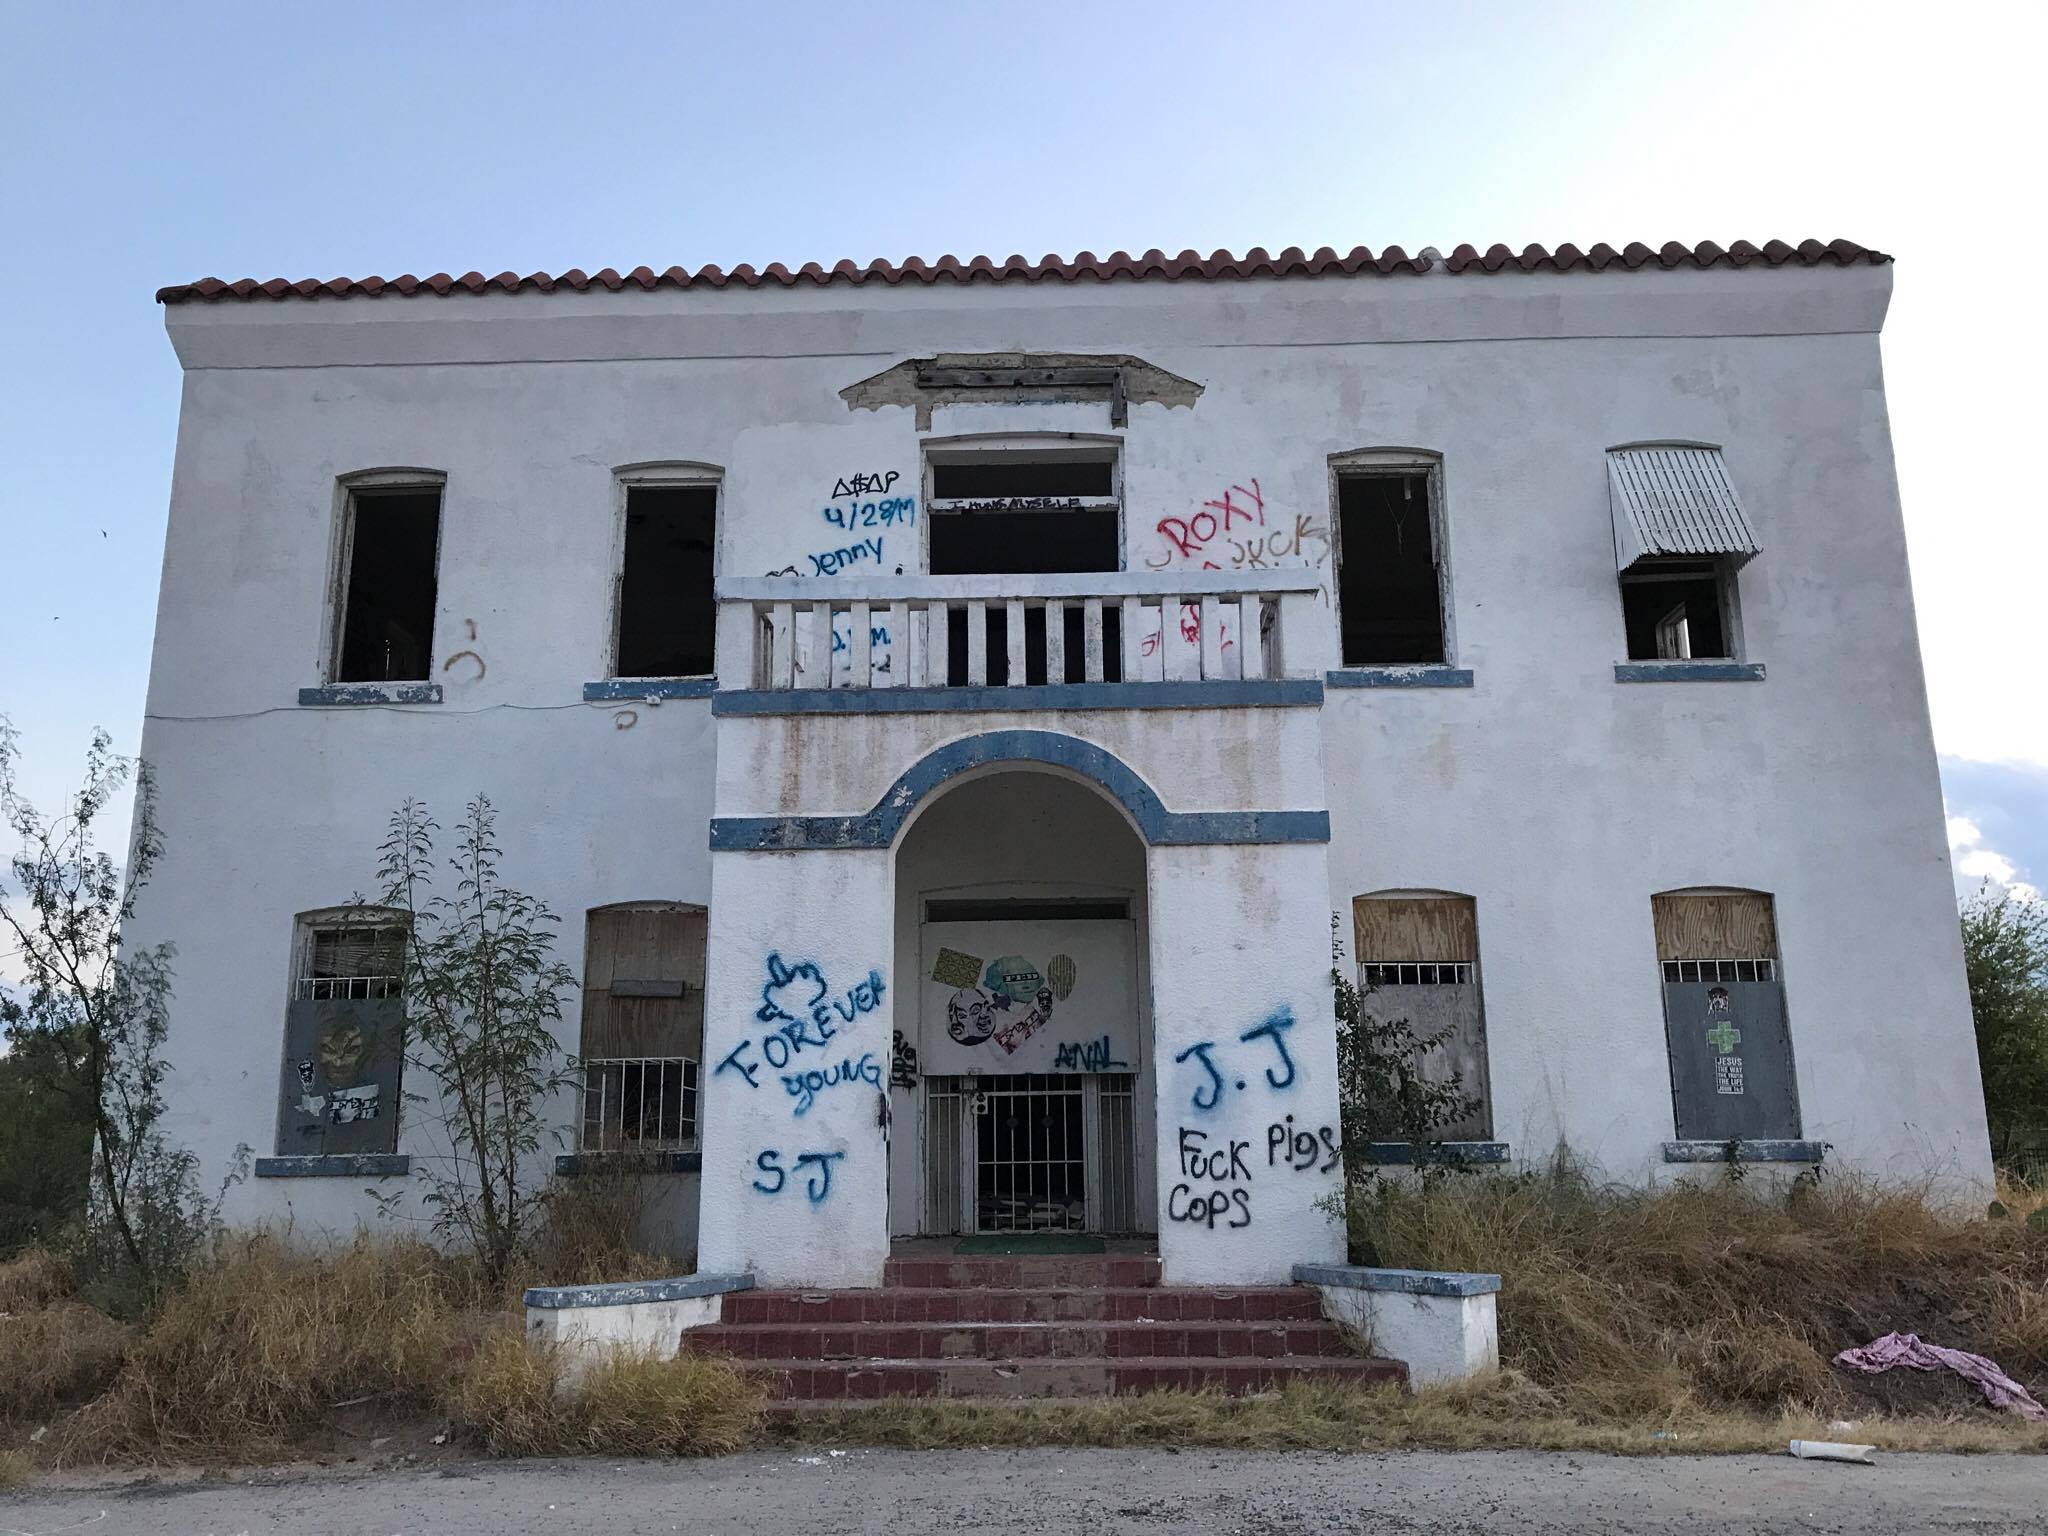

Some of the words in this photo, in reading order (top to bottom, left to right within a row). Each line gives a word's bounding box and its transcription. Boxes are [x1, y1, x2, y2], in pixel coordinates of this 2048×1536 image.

[1157, 478, 1265, 558] ROXY
[714, 968, 887, 1089] FOREVER
[1717, 1057, 1742, 1066] JESUS
